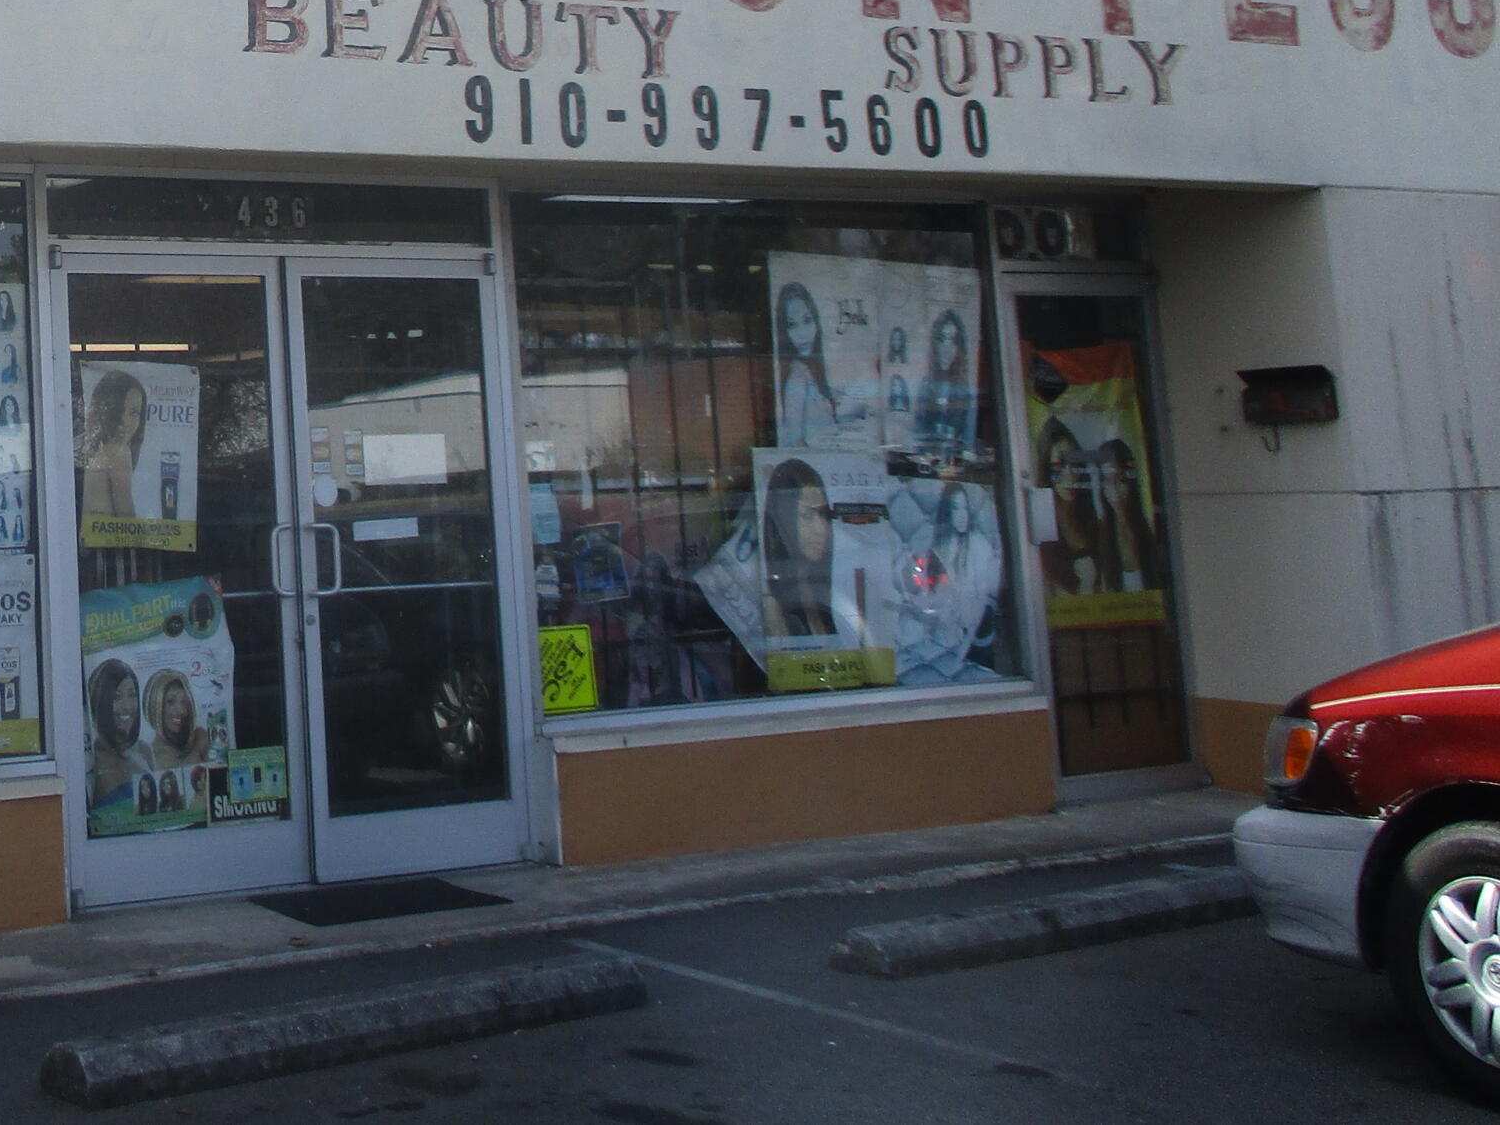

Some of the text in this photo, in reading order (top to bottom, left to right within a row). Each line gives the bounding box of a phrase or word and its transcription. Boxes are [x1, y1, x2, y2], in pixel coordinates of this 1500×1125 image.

[883, 25, 1188, 106] SUPPLY
[464, 74, 989, 159] 910-997-5600
[237, 195, 306, 228] 436
[146, 403, 195, 424] PURE
[91, 521, 147, 535] FASHION
[131, 594, 172, 621] PART
